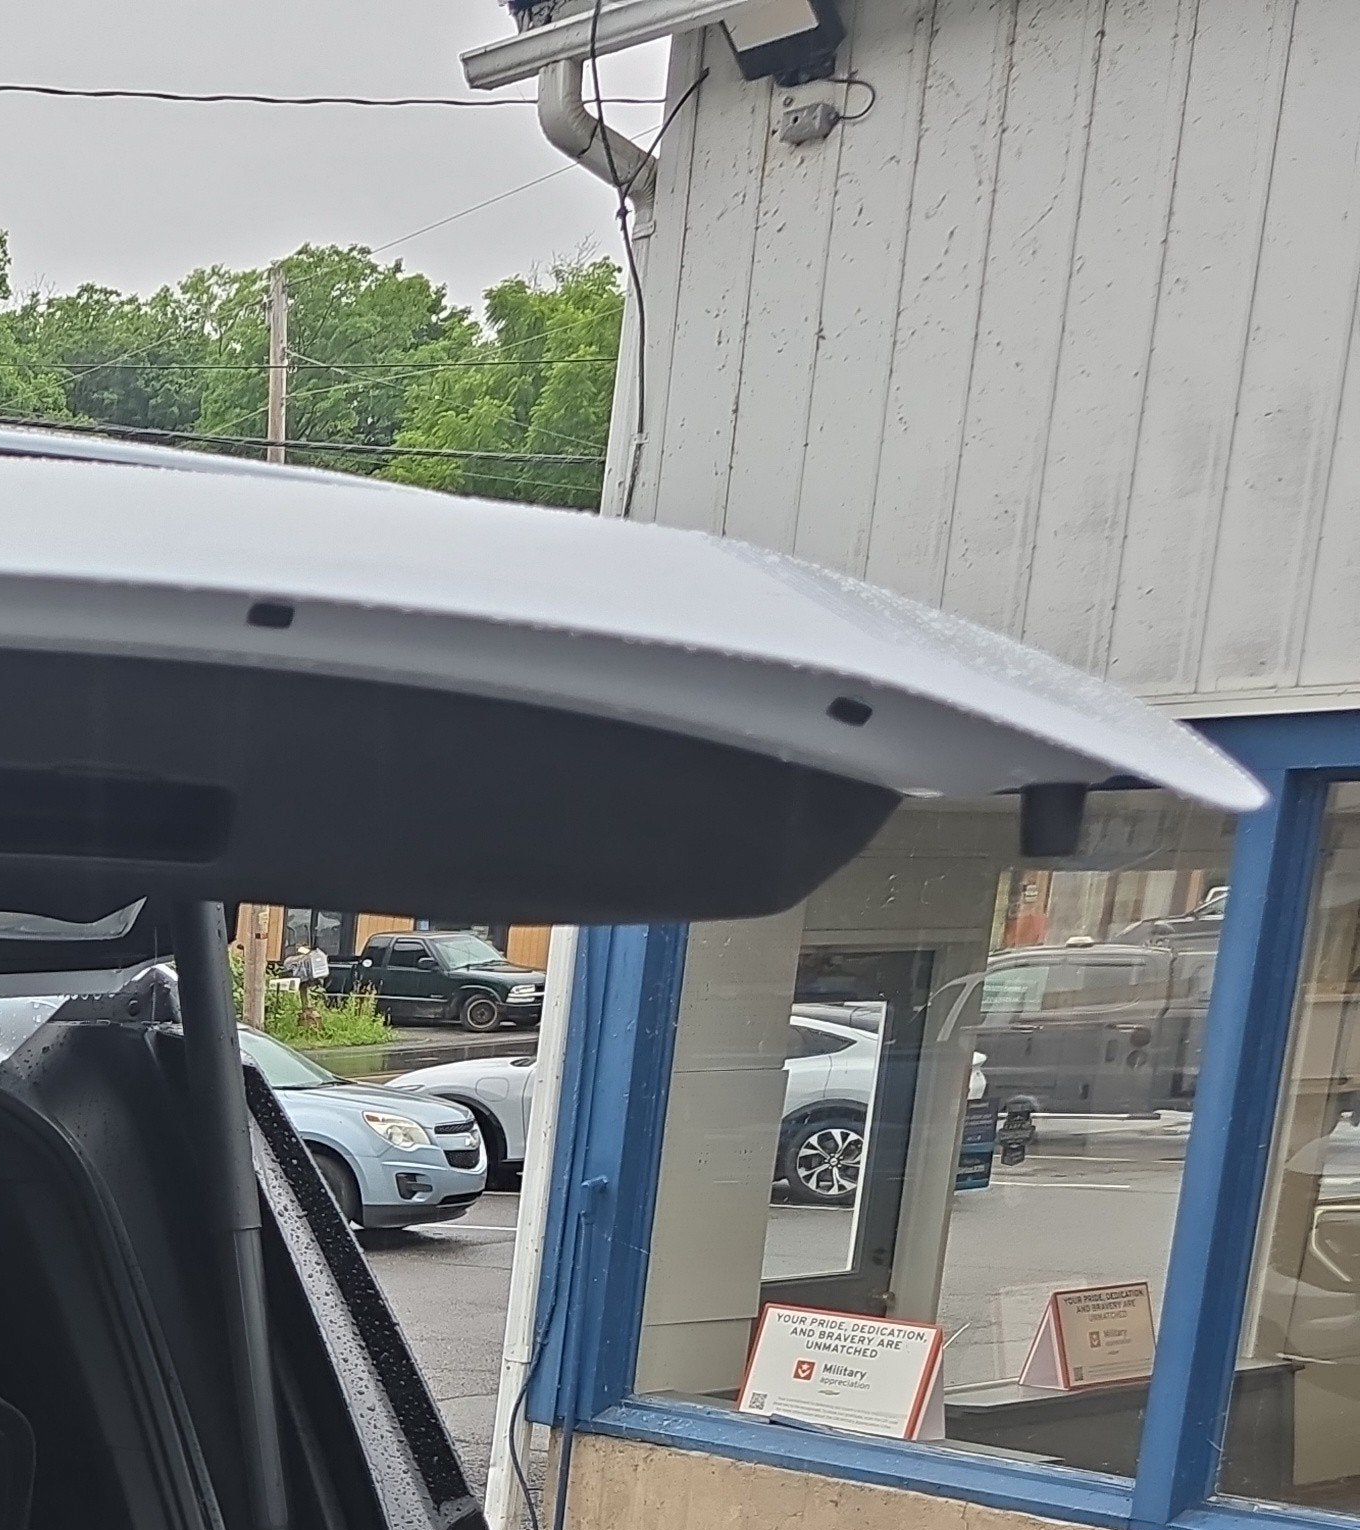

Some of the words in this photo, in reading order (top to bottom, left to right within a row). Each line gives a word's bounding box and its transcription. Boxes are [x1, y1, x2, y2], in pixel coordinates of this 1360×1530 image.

[777, 1313, 808, 1326] YOUR
[810, 1318, 848, 1332] PRIDE,
[851, 1323, 928, 1343] DEDICATION,
[790, 1327, 815, 1338] AND
[818, 1330, 874, 1346] BRAVERY
[877, 1339, 902, 1350] ARE
[805, 1340, 878, 1358] UNMATCHED
[822, 1363, 867, 1381] Military
[819, 1376, 870, 1390] appreciation
